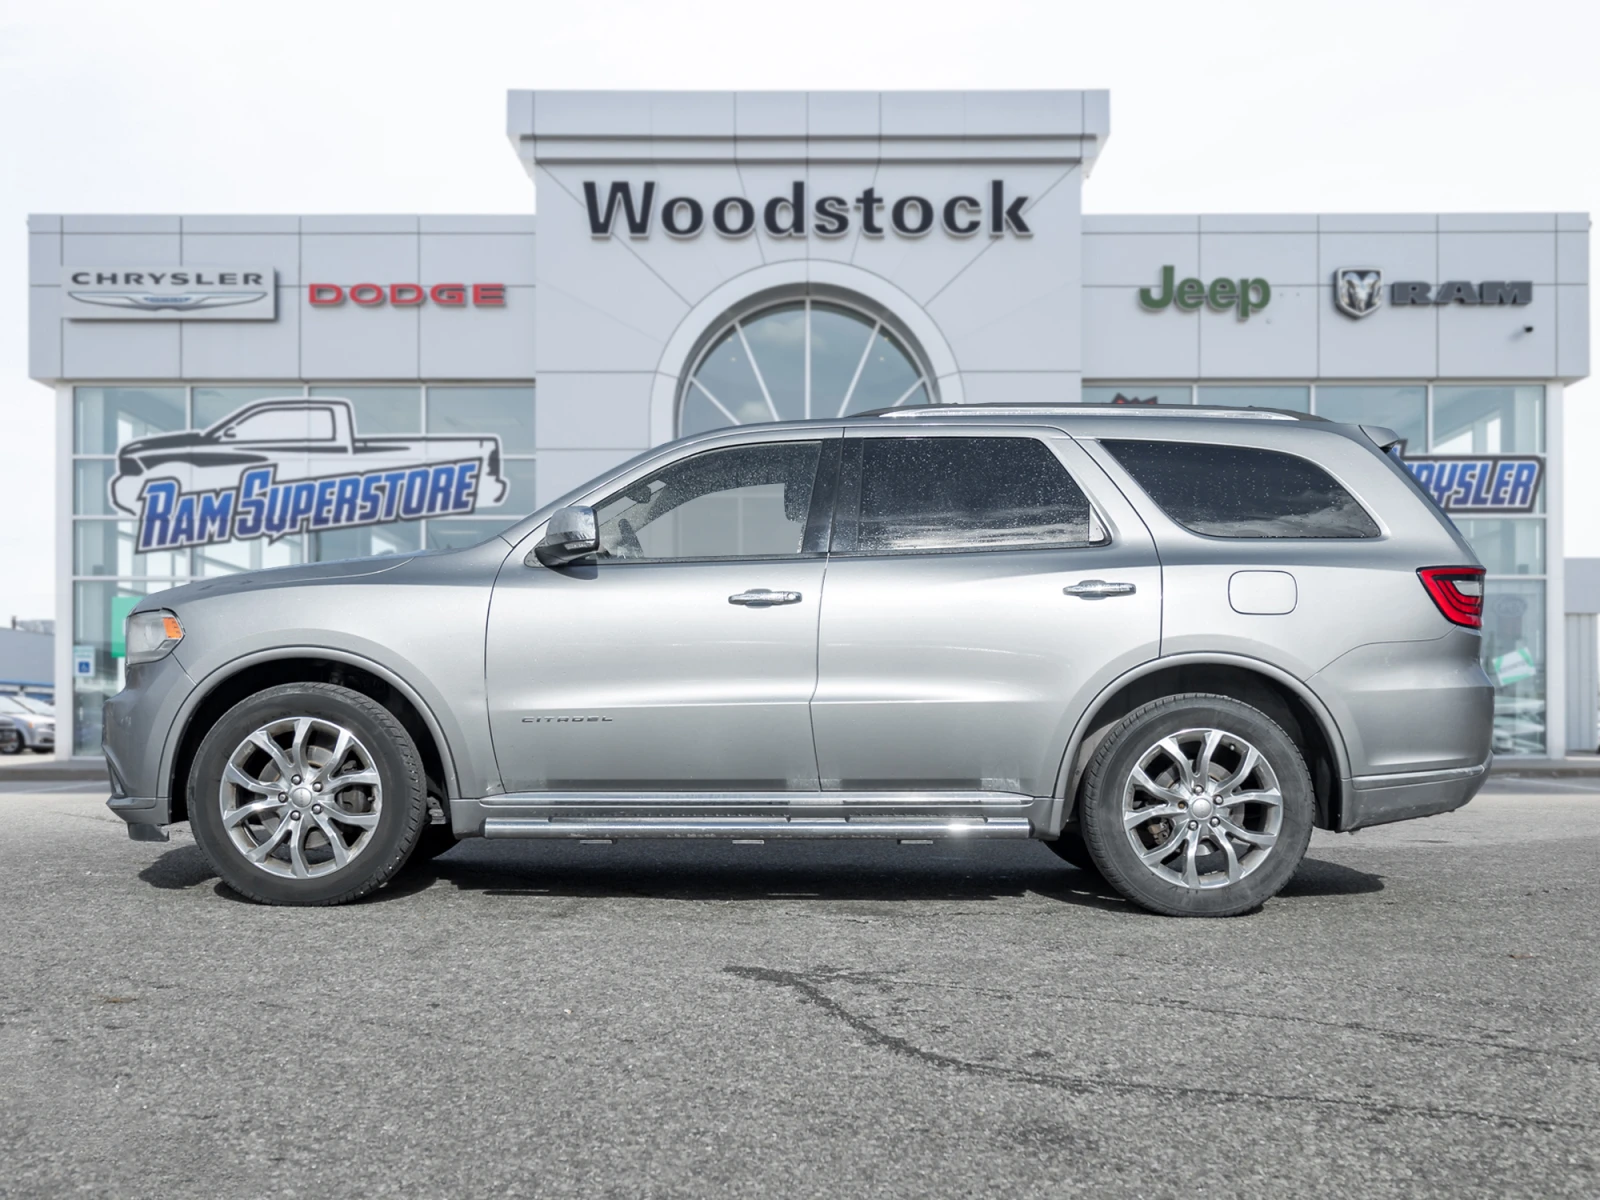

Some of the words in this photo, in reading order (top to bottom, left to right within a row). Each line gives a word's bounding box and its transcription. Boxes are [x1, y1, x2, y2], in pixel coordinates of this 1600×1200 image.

[583, 179, 1034, 238] Woodstock
[71, 271, 264, 286] CHRYSLER
[308, 283, 506, 306] DODGE
[1138, 264, 1271, 321] Jeep
[1390, 280, 1533, 306] RAM
[1400, 458, 1538, 507] RYSLER
[521, 715, 613, 723] CITADEL
